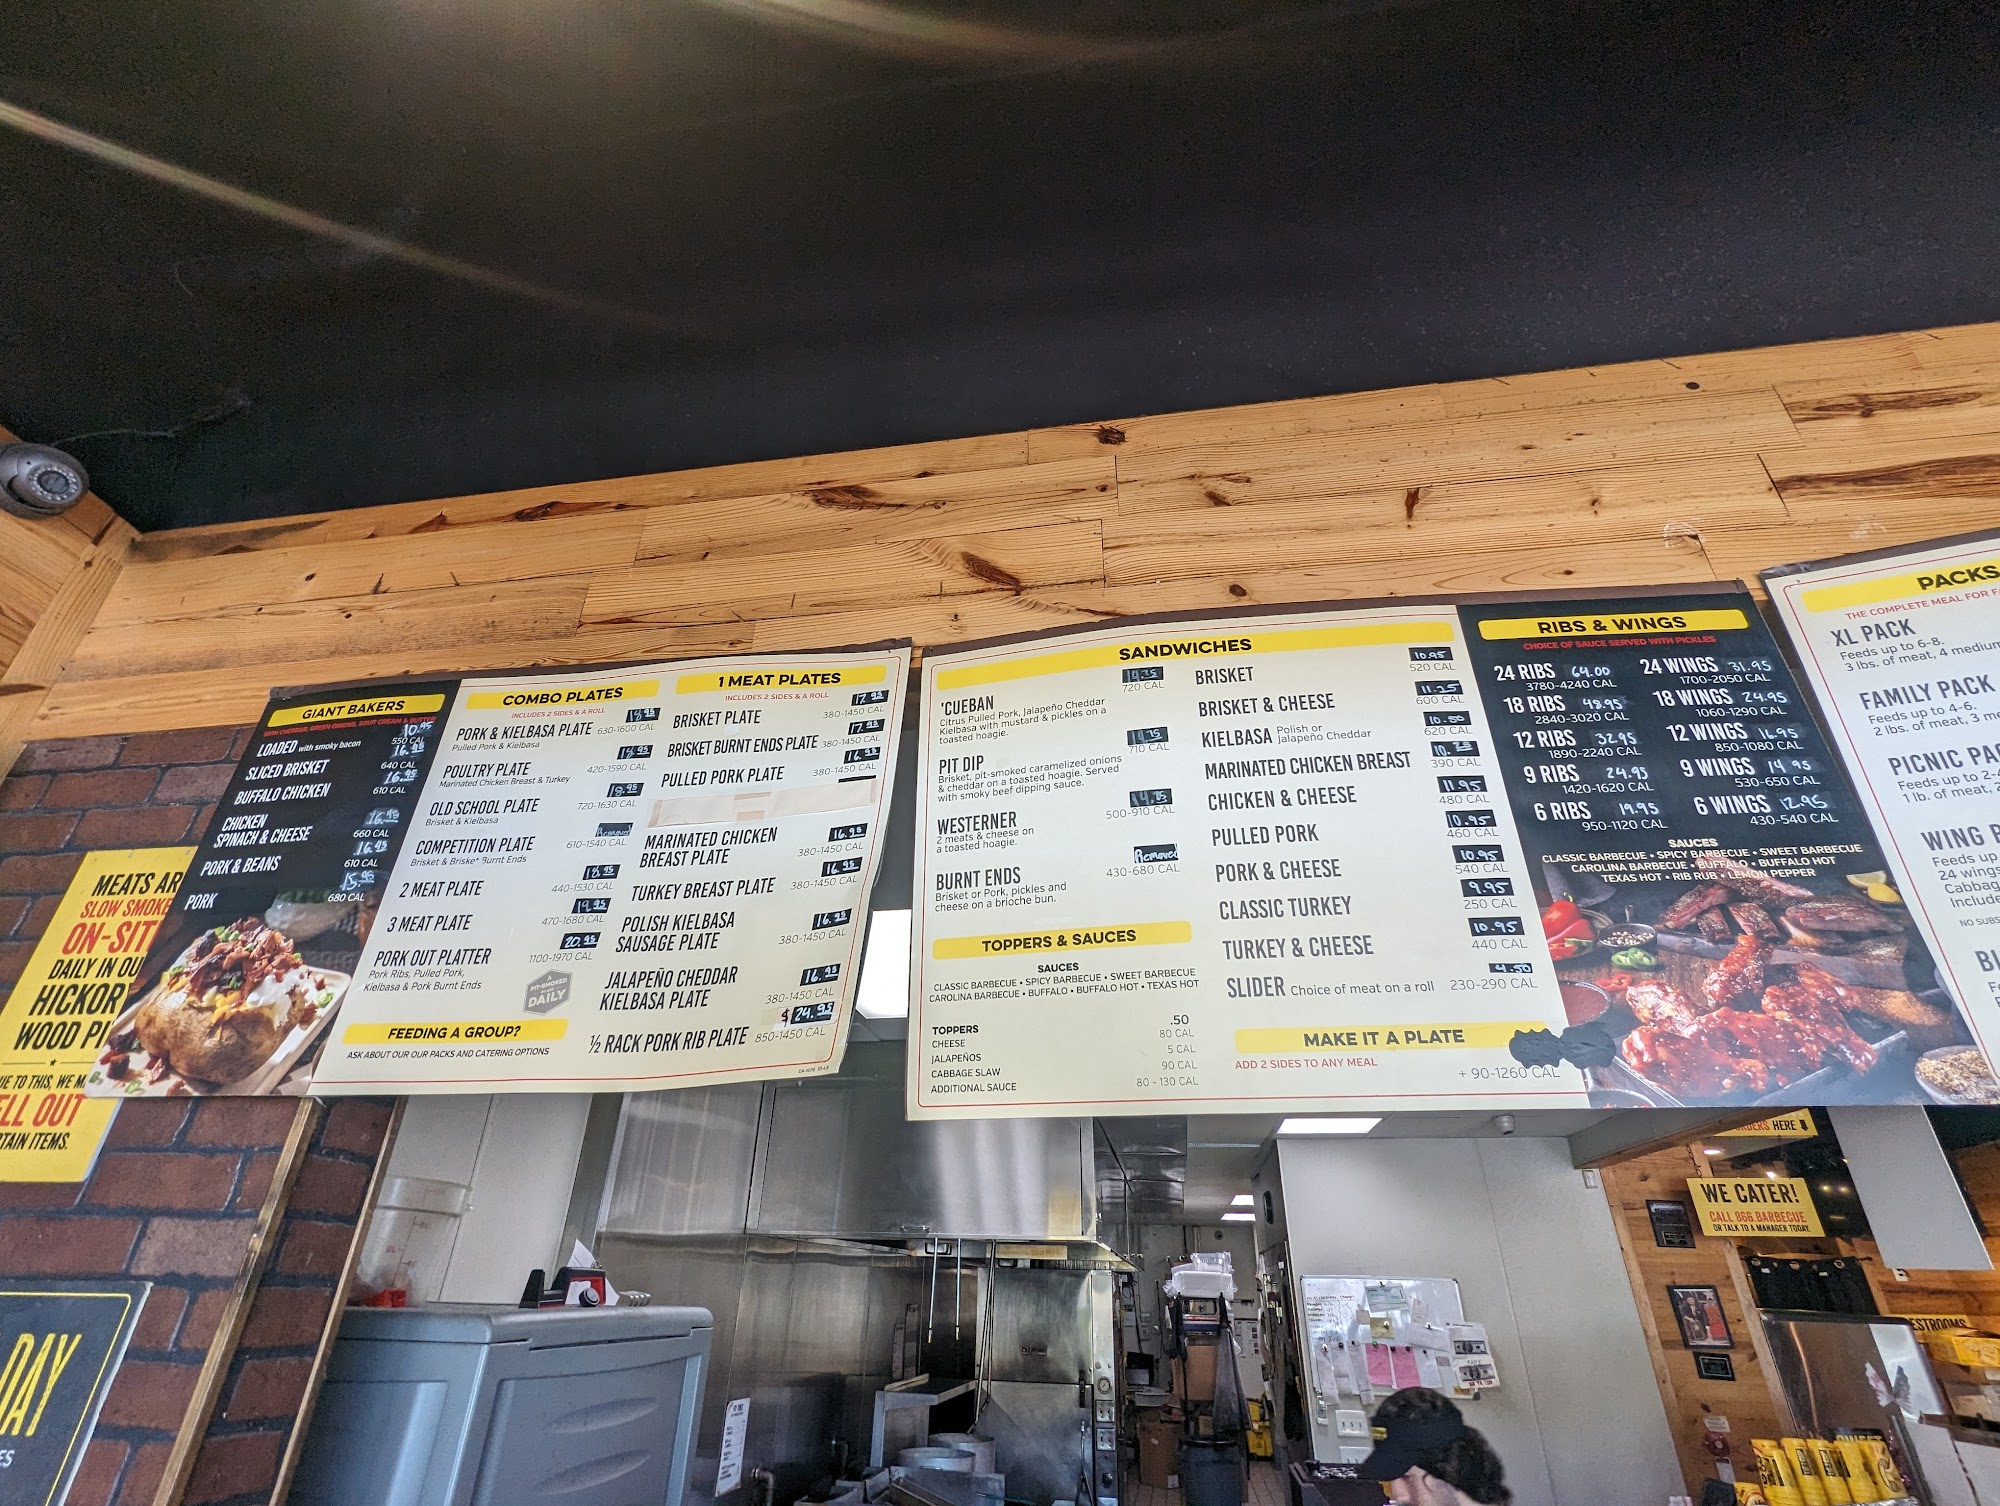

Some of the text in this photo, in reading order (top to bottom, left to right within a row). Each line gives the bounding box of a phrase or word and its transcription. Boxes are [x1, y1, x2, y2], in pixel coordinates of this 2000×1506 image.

[1915, 566, 2000, 591] PACKS
[1537, 616, 1687, 634] RIBS & WINGS
[1830, 618, 1916, 647] XL PACK
[1119, 638, 1252, 661] SANDWICHES
[1414, 650, 1445, 661] 10.95
[1840, 637, 1945, 660] Feeds up to 6-8.
[718, 672, 841, 687] 1 MEAT PLATES
[1195, 666, 1253, 685] BRISKET
[1494, 663, 1610, 681] 24 RIBS 64.00
[1122, 682, 1164, 692] 720 CAL
[1526, 679, 1617, 691] 3780-4240 CAL
[502, 686, 624, 706] COMBO PLATES
[302, 700, 405, 720] GIANT BAKERS
[673, 710, 762, 729] BRISKET PLATE
[939, 697, 1106, 727] Citrus Pulled Pork, Jalapeño Cheddar
[257, 740, 362, 757] LOADED with smoky bacon
[408, 736, 425, 744] CAL
[245, 759, 330, 781] SLICED BRISKET
[443, 762, 532, 779] POULTRY PLATE
[939, 755, 984, 775] PIT DIP
[439, 779, 477, 788] Marinated
[479, 778, 509, 786] Chicken
[510, 777, 535, 785] Breast
[546, 775, 571, 785] Turkey
[234, 783, 332, 805] BUFFALO CHICKEN
[222, 814, 269, 832] CHICKEN
[214, 825, 314, 849] SPINACH & CHEESE
[200, 855, 282, 877] PORK & BEANS
[1601, 868, 1816, 883] TEXAS HOT RIB RUB LEMON PEPPER
[91, 871, 184, 897] MEATS AR
[631, 877, 777, 902] TURKEY BREAST PLATE
[184, 893, 218, 911] PORK
[328, 893, 365, 902] 680 CAL
[1463, 898, 1518, 910] 250 CAL
[80, 898, 173, 919] SLOW SMOKE
[1219, 895, 1352, 921] CLASSIC TURKEY
[62, 920, 158, 955] ON-SIT
[982, 929, 1137, 953] TOPPERS & SAUCES
[373, 948, 492, 967] PORK OUT PLATTER
[529, 952, 593, 964] 1100-1970 CAL
[48, 956, 146, 980] DAILY IN OU
[368, 968, 465, 979] Pork Ribs, Pulled Pork,
[604, 965, 739, 989] JALAPEÑO CHEDDAR
[530, 977, 568, 992] PIT-SMOKED
[1226, 976, 1435, 998] SLIDER Choice of meat on a roll
[28, 983, 131, 1016] HICKOR
[528, 989, 566, 1008] DAILY
[13, 1021, 114, 1050] WOOD PI
[387, 1025, 521, 1040] FEEDING A GROUP?
[1304, 1029, 1465, 1047] MAKE IT A PLATE
[347, 1047, 550, 1060] ASK ABOUT OUR OUR PACKS AND CATERING OPTIONS
[931, 1053, 982, 1065] JALAPEÑOS
[13, 1075, 28, 1089] TO
[28, 1075, 54, 1091] THIS,
[56, 1074, 75, 1089] WE
[0, 1093, 87, 1127] ELL OUT
[1772, 1119, 1797, 1131] HERE
[28, 1132, 70, 1150] ITEMS.
[1700, 1183, 1798, 1204] WE CATER!
[1709, 1211, 1733, 1222] CALL
[1713, 1224, 1723, 1232] OR
[1723, 1224, 1740, 1232] TALK
[1740, 1224, 1750, 1232] TO
[1751, 1224, 1756, 1232] A
[1757, 1224, 1787, 1232] MANAGER
[1911, 1318, 1967, 1332] ESTROOMS
[0, 1333, 82, 1437] DAY
